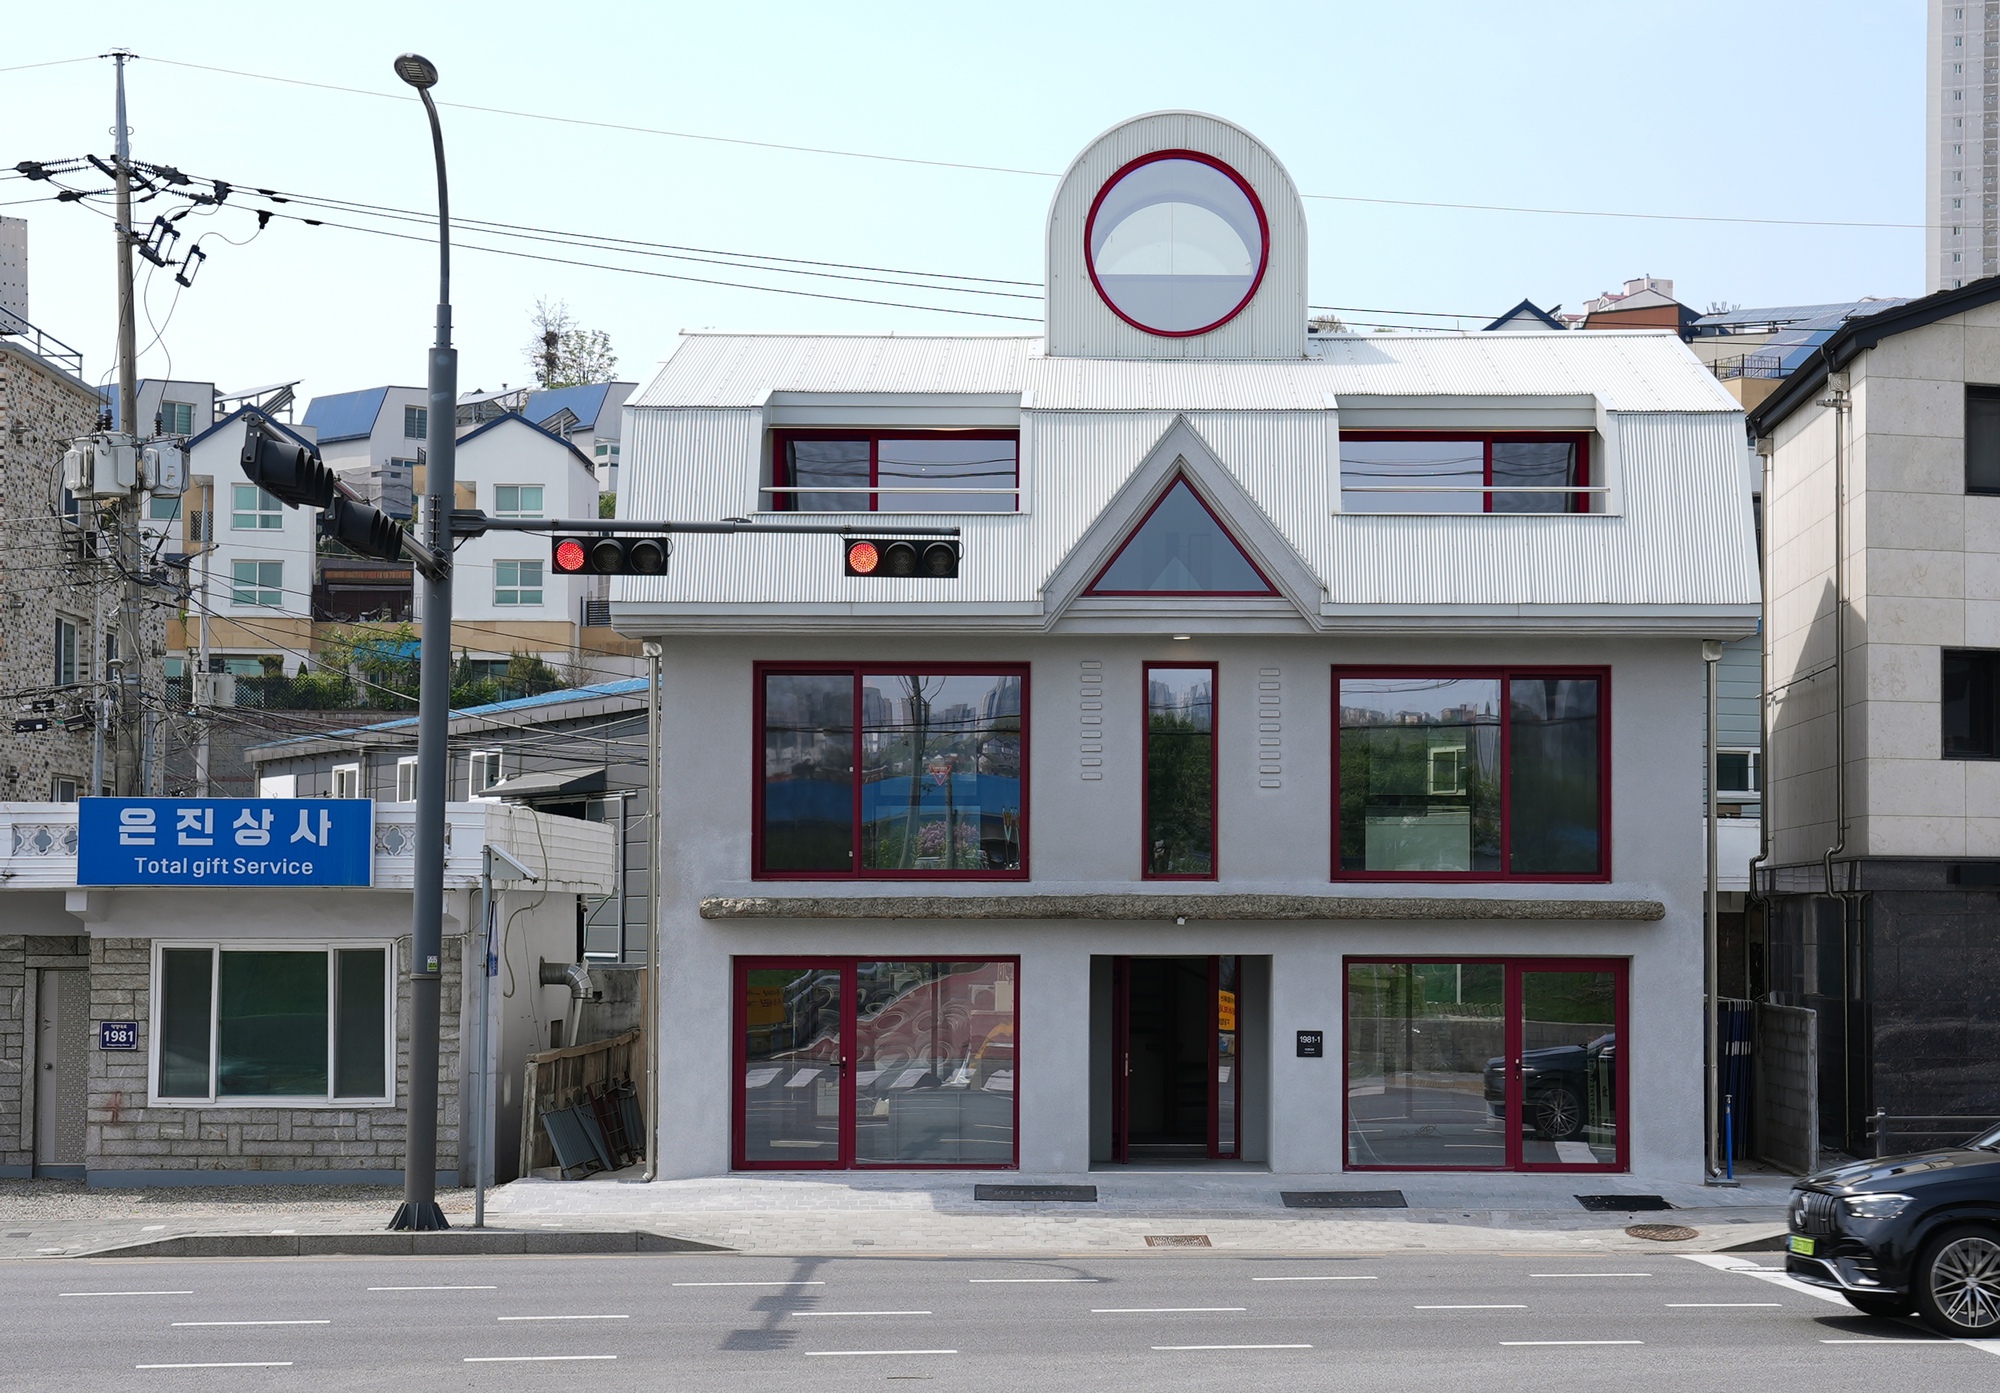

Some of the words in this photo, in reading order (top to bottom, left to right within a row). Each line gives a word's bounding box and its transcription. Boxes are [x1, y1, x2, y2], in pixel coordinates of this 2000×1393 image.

[134, 857, 188, 874] Total
[192, 857, 229, 878] gift
[233, 858, 314, 875] Service
[103, 1030, 134, 1042] 1981
